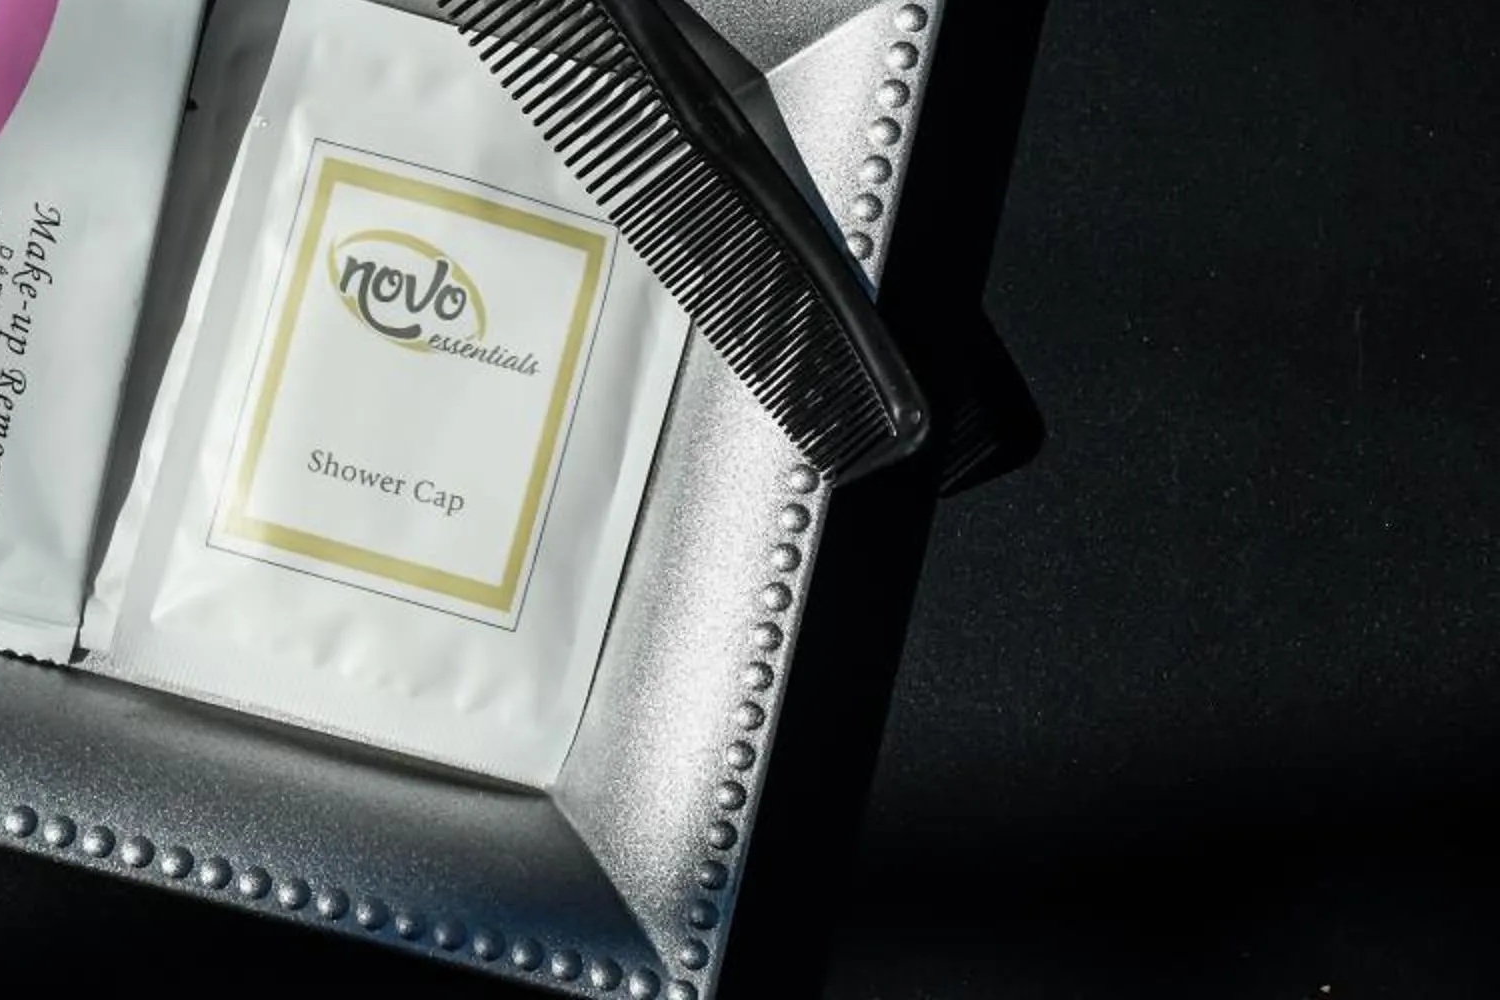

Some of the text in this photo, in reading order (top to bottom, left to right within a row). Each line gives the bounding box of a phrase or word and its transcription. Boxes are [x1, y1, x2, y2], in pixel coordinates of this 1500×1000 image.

[339, 255, 468, 339] novo
[307, 449, 465, 517] Shower Cap
